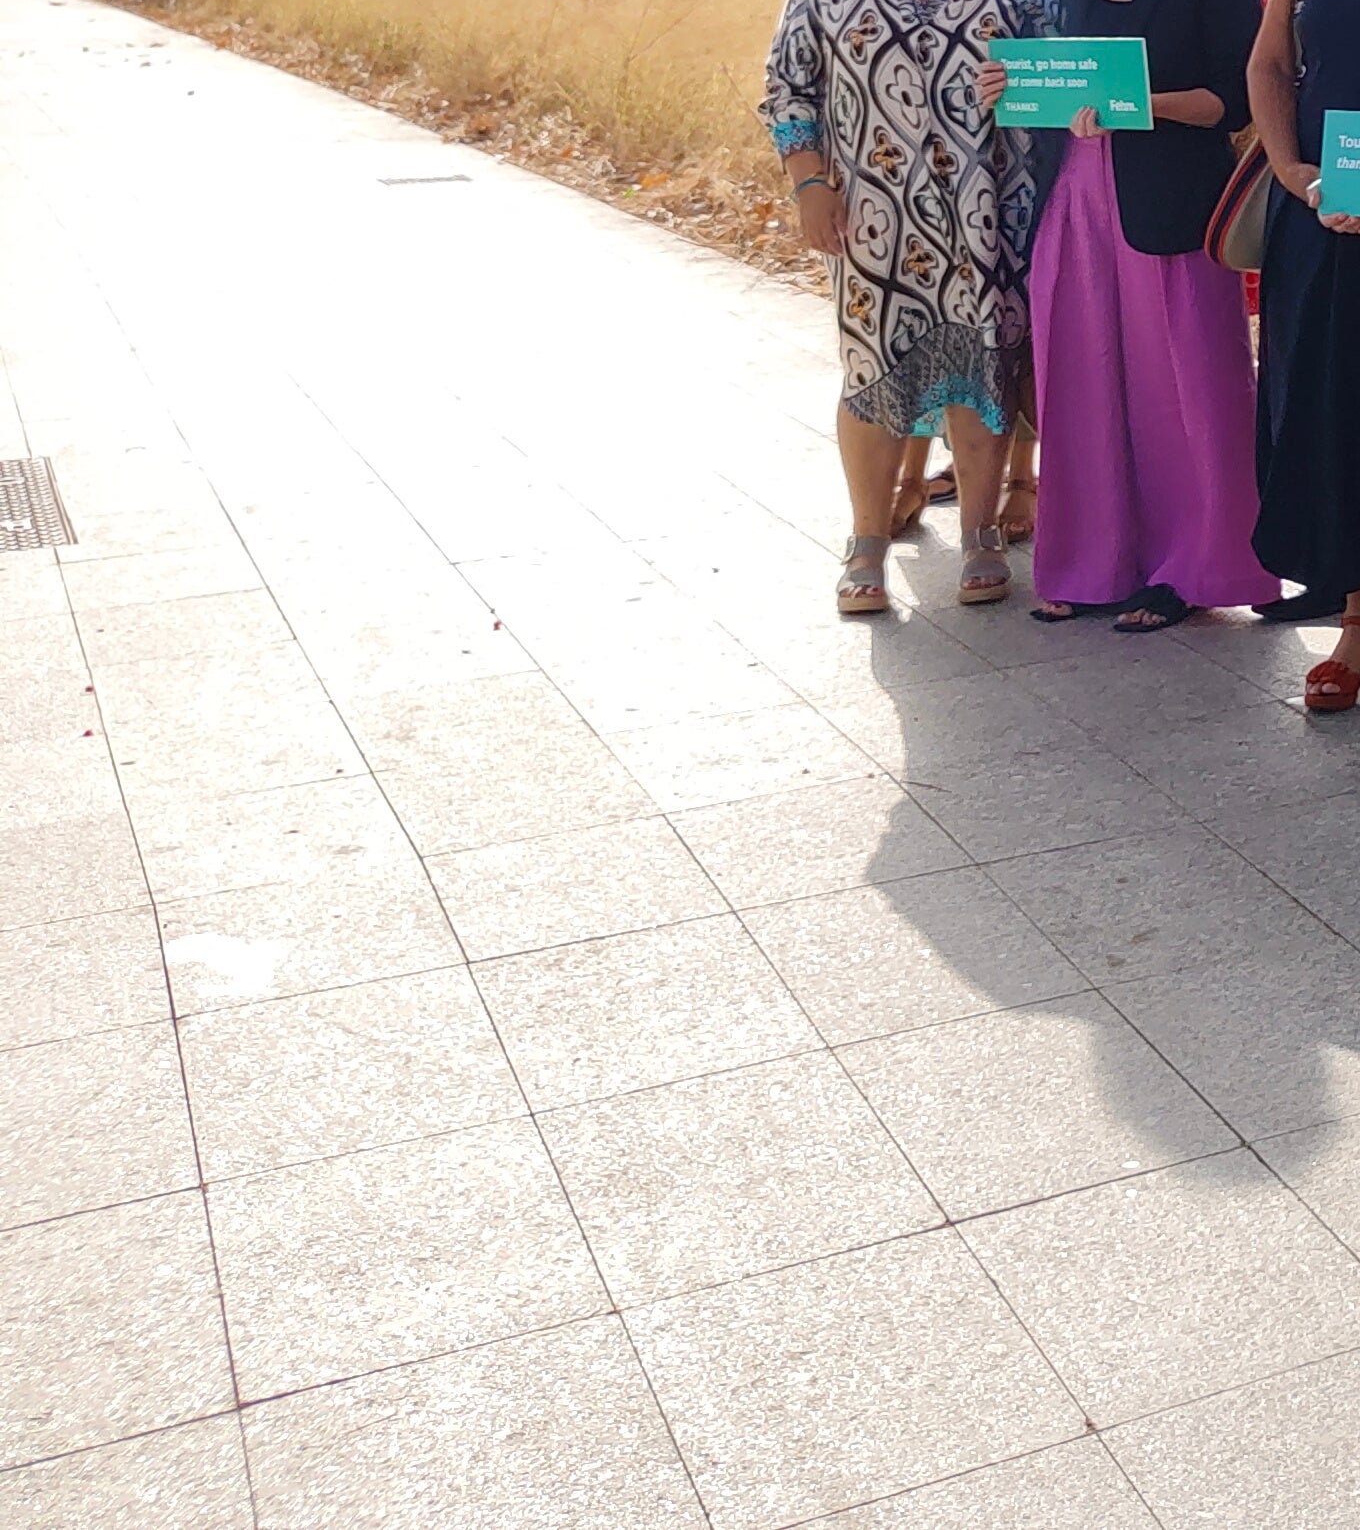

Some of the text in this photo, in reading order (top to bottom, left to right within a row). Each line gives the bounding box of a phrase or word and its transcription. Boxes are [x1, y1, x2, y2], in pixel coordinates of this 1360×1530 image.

[1036, 60, 1049, 71] go
[1051, 59, 1077, 70] home
[1079, 57, 1098, 70] safe
[1006, 76, 1088, 88] nd come back soon
[1109, 99, 1138, 112] Fehm.
